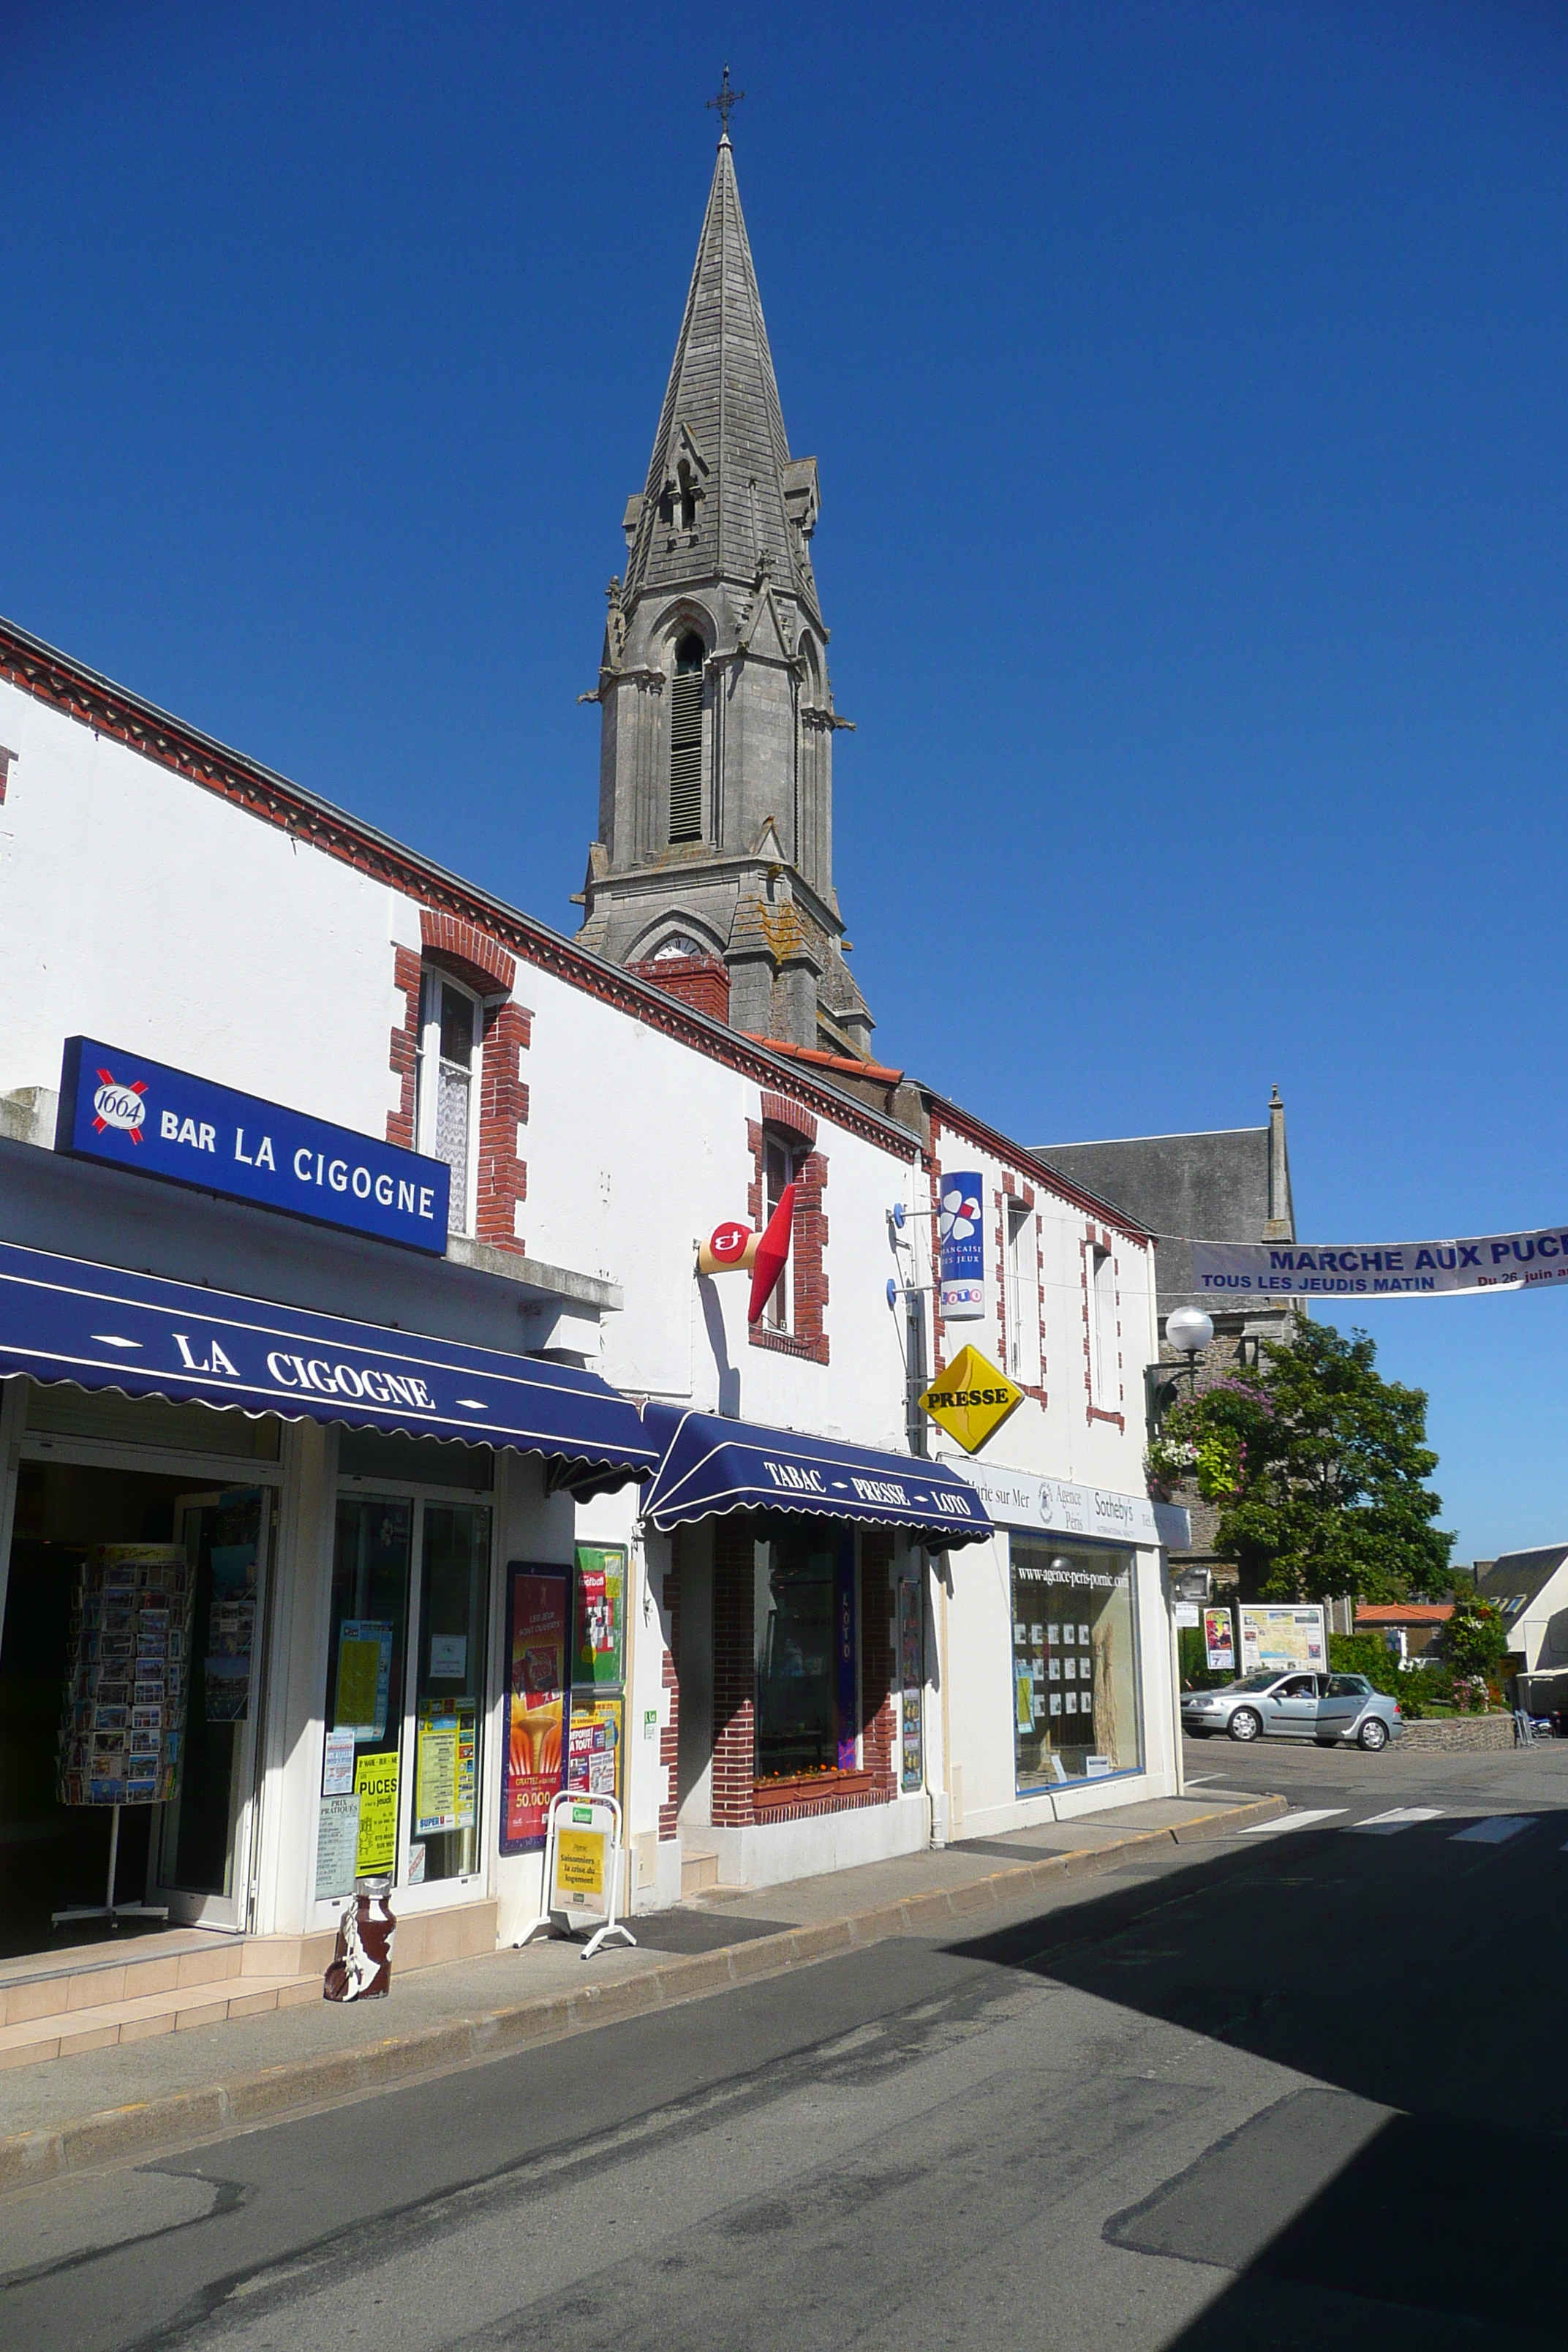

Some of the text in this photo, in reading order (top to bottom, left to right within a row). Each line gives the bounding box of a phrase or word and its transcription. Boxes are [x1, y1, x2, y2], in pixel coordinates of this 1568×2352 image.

[97, 1090, 142, 1123] 1664
[160, 1110, 434, 1219] BAR LA CIGOGNE
[957, 1256, 979, 1264] JEUX
[1270, 1251, 1404, 1273] MARCHE
[1415, 1245, 1482, 1270] AUX
[1202, 1275, 1435, 1292] TOUS LES JEUDIS MATIN
[1477, 1276, 1497, 1286] Du
[1501, 1272, 1518, 1284] 26
[1525, 1269, 1553, 1284] juin
[172, 1333, 437, 1409] LA CIGOGNE
[927, 1388, 1009, 1409] PRESSE
[764, 1461, 971, 1515] TABAC PRESSE LOTO
[1057, 1484, 1082, 1508] Agence
[995, 1488, 1010, 1504] sur
[1012, 1488, 1030, 1508] Mer
[1095, 1492, 1134, 1527] Sotheby's
[530, 1611, 555, 1623] LES JEUX
[519, 1626, 535, 1636] SONT
[360, 1778, 397, 1796] PUCES
[516, 1776, 538, 1786] GRATTEZ
[377, 1795, 392, 1807] jeudi
[516, 1791, 550, 1807] 50.000
[320, 1803, 358, 1815] PRATIQUÉS
[420, 1817, 439, 1828] SUPER
[440, 1815, 445, 1825] U
[561, 1854, 595, 1864] Saisonniers
[571, 1866, 585, 1874] crise
[587, 1866, 595, 1874] du
[565, 1874, 594, 1884] logement
